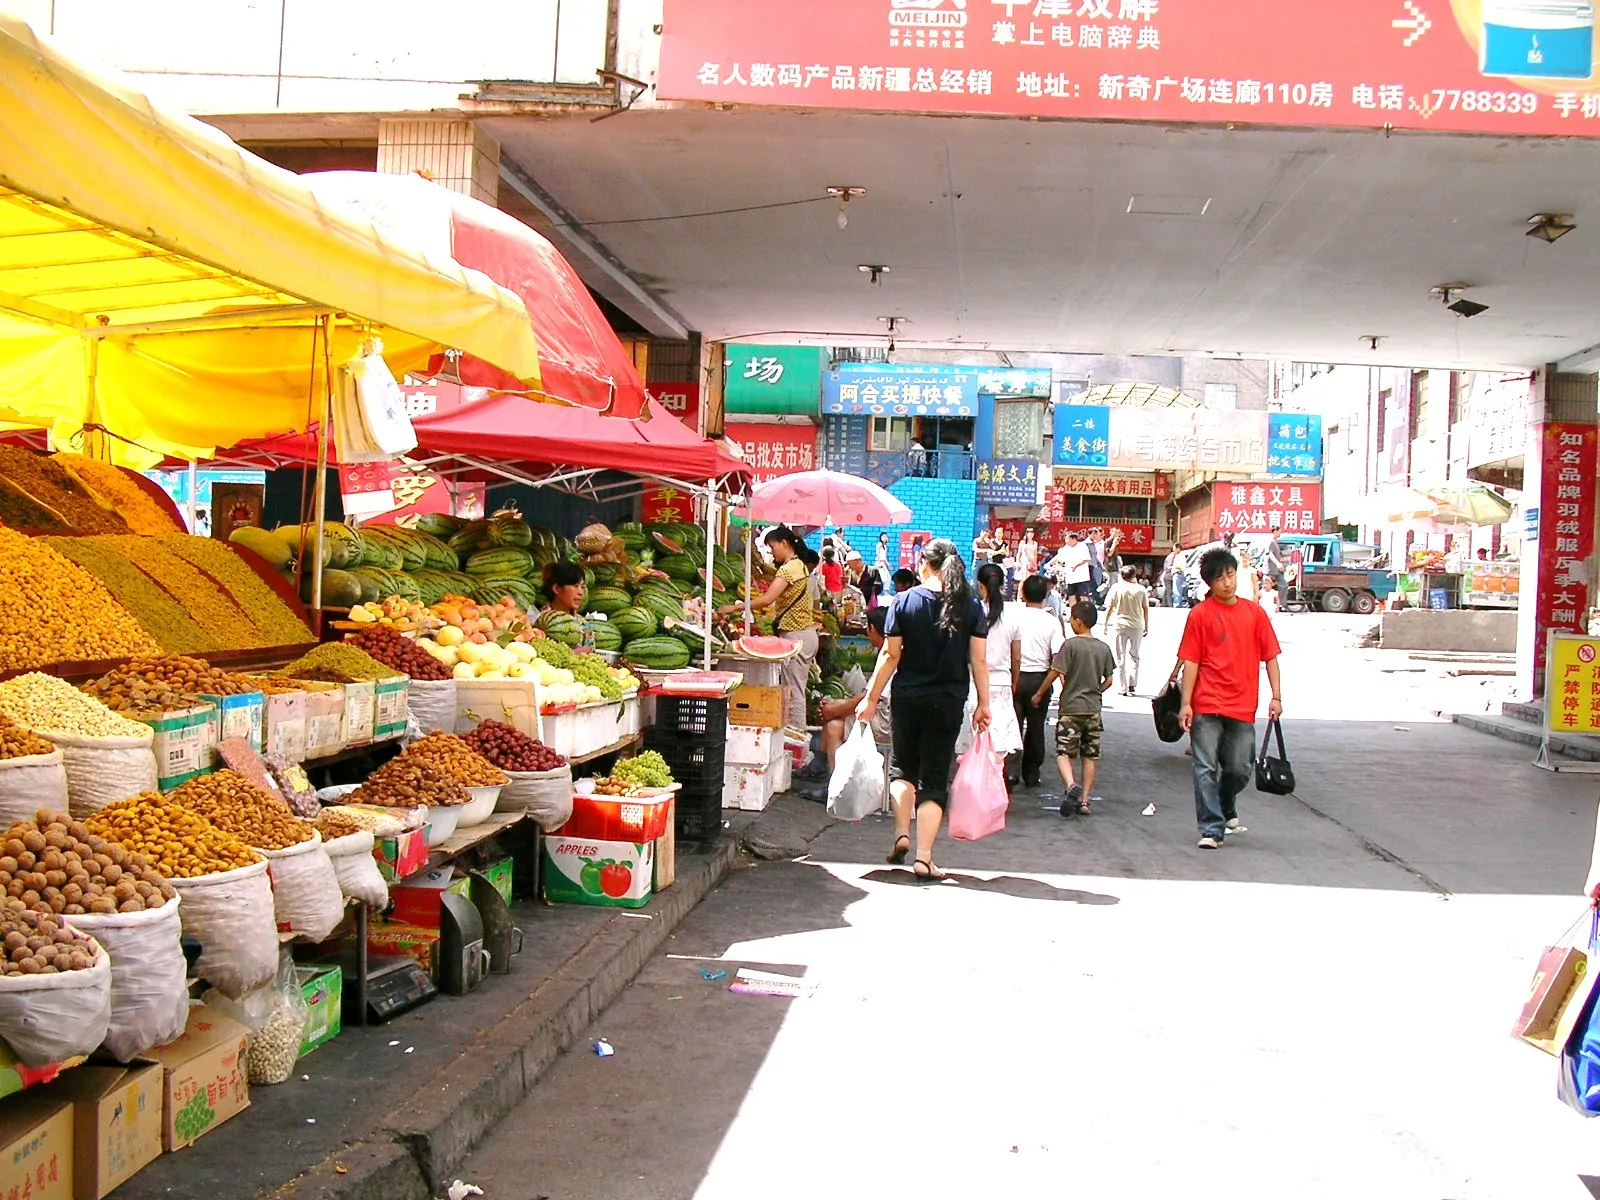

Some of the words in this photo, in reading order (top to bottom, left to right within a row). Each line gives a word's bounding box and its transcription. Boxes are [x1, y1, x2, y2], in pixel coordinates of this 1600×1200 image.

[895, 12, 961, 24] MEIJIN
[991, 20, 1161, 50] 掌上电脑辞典
[696, 61, 994, 95] 名人数码产品新疆总经销
[1098, 73, 1334, 109] 新奇广场连廊110房
[724, 356, 784, 384] 场
[839, 383, 963, 406] 阿合买提快餐
[1071, 417, 1096, 430] 二楼
[1060, 436, 1108, 454] 美食街
[1053, 476, 1153, 496] 文化办公体育用品
[1230, 485, 1304, 507] 雅鑫文具
[1218, 508, 1316, 531] 办公体育用品
[1551, 431, 1584, 634] 知名品牌羽绒服反季大酬
[1562, 664, 1581, 727] 严禁停车
[554, 844, 599, 857] APPLES
